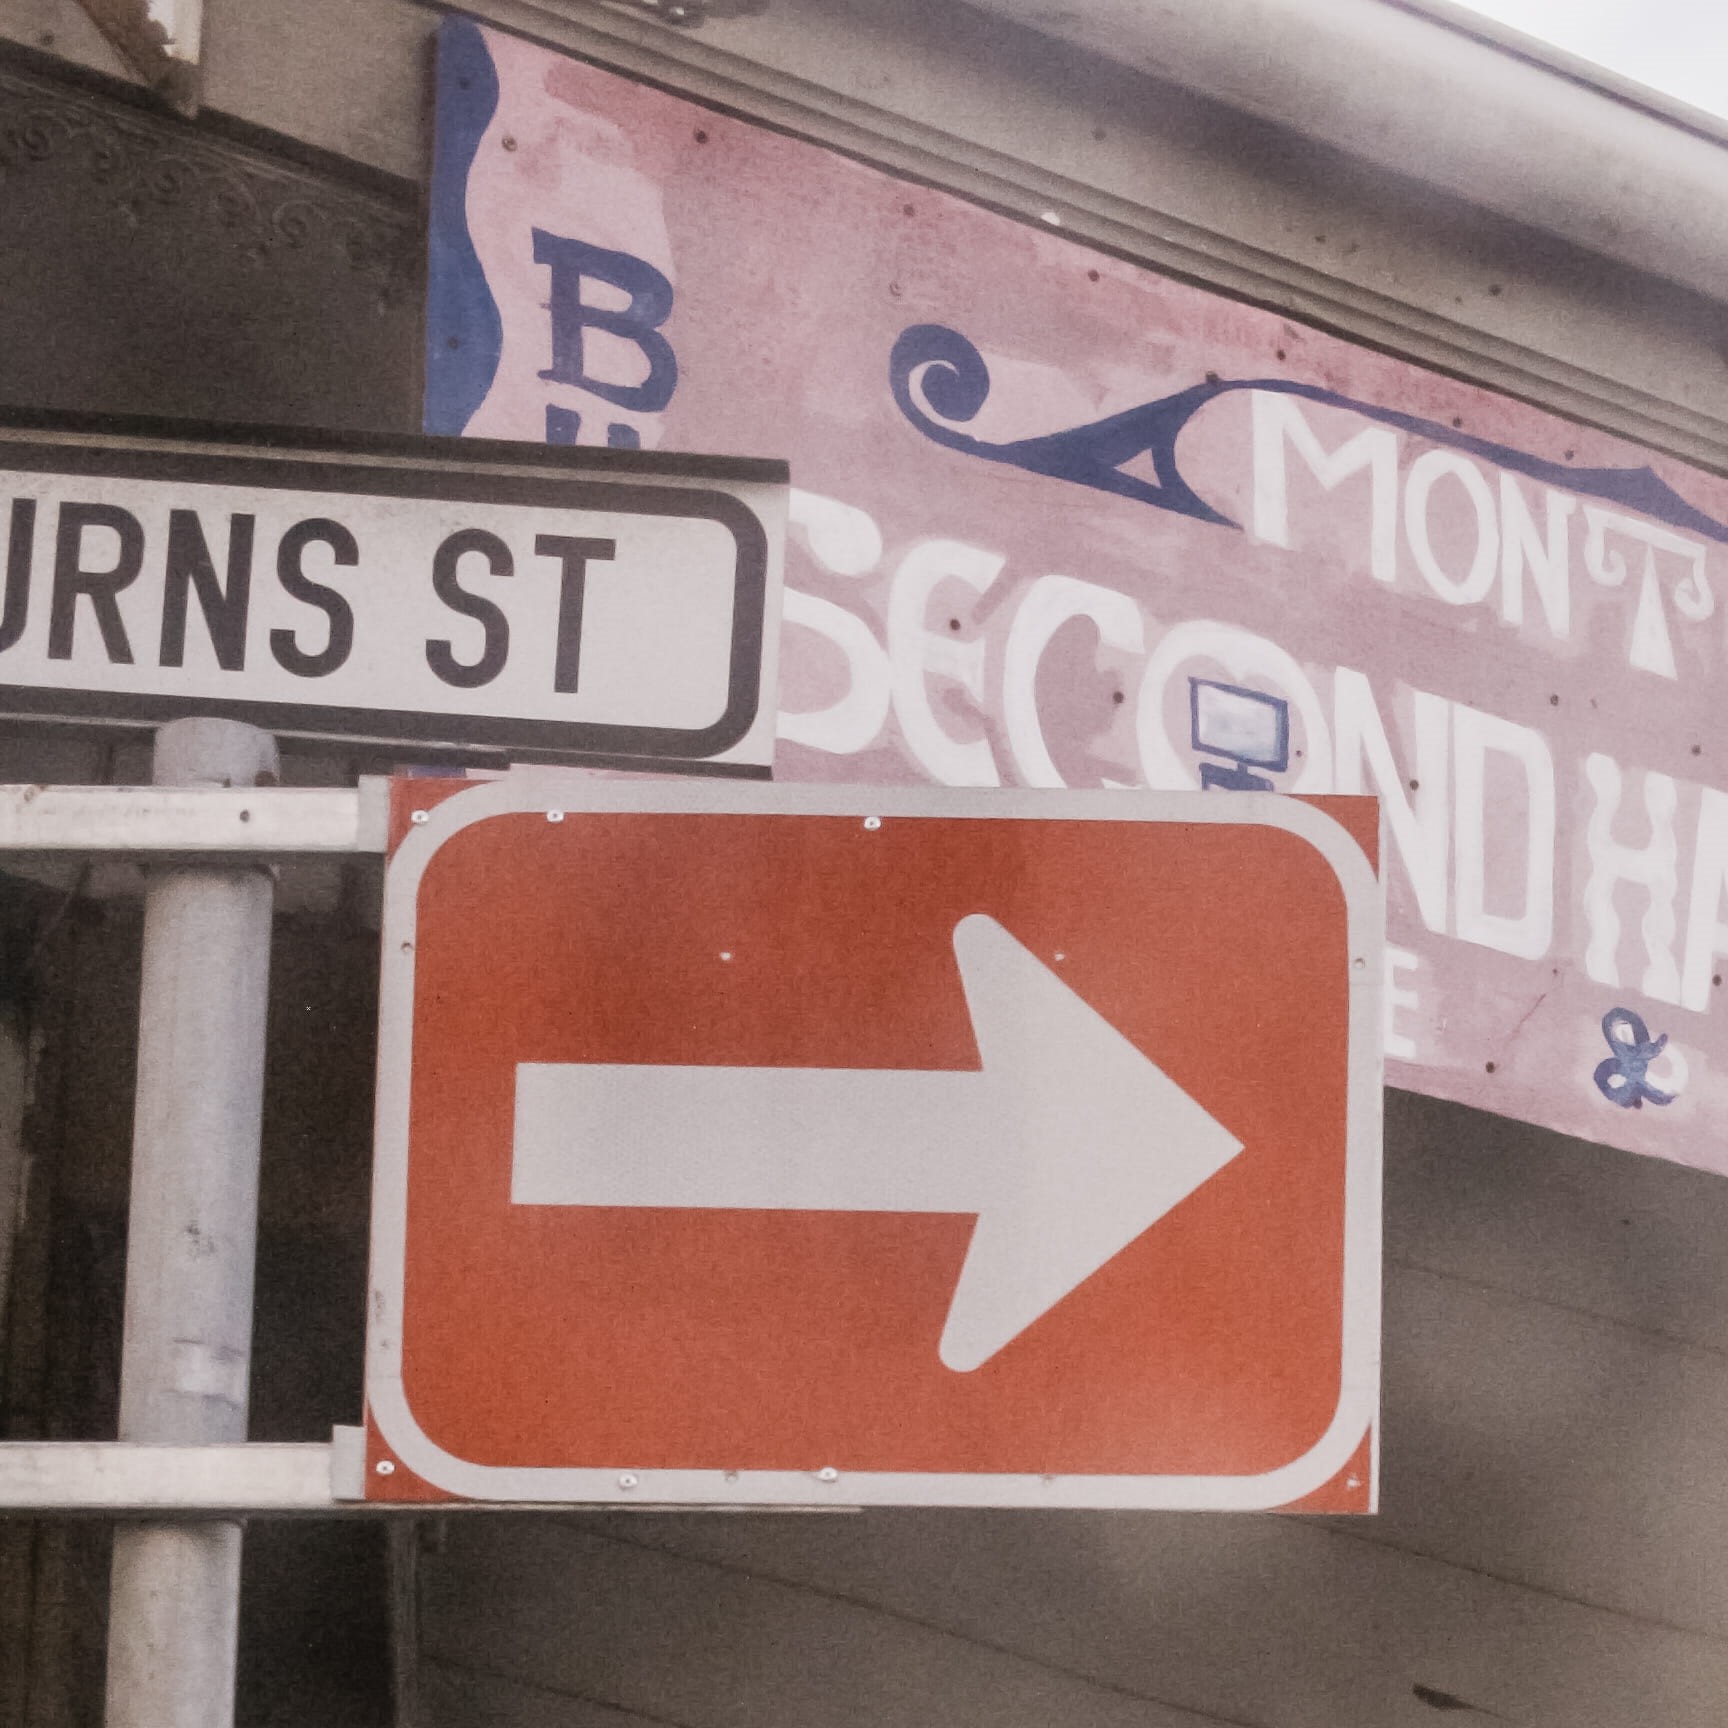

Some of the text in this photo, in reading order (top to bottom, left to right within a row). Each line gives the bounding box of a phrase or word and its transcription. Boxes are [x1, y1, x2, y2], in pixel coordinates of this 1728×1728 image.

[424, 528, 617, 695] ST
[778, 486, 1556, 961] SECOND
[1592, 1005, 1690, 1110] &
